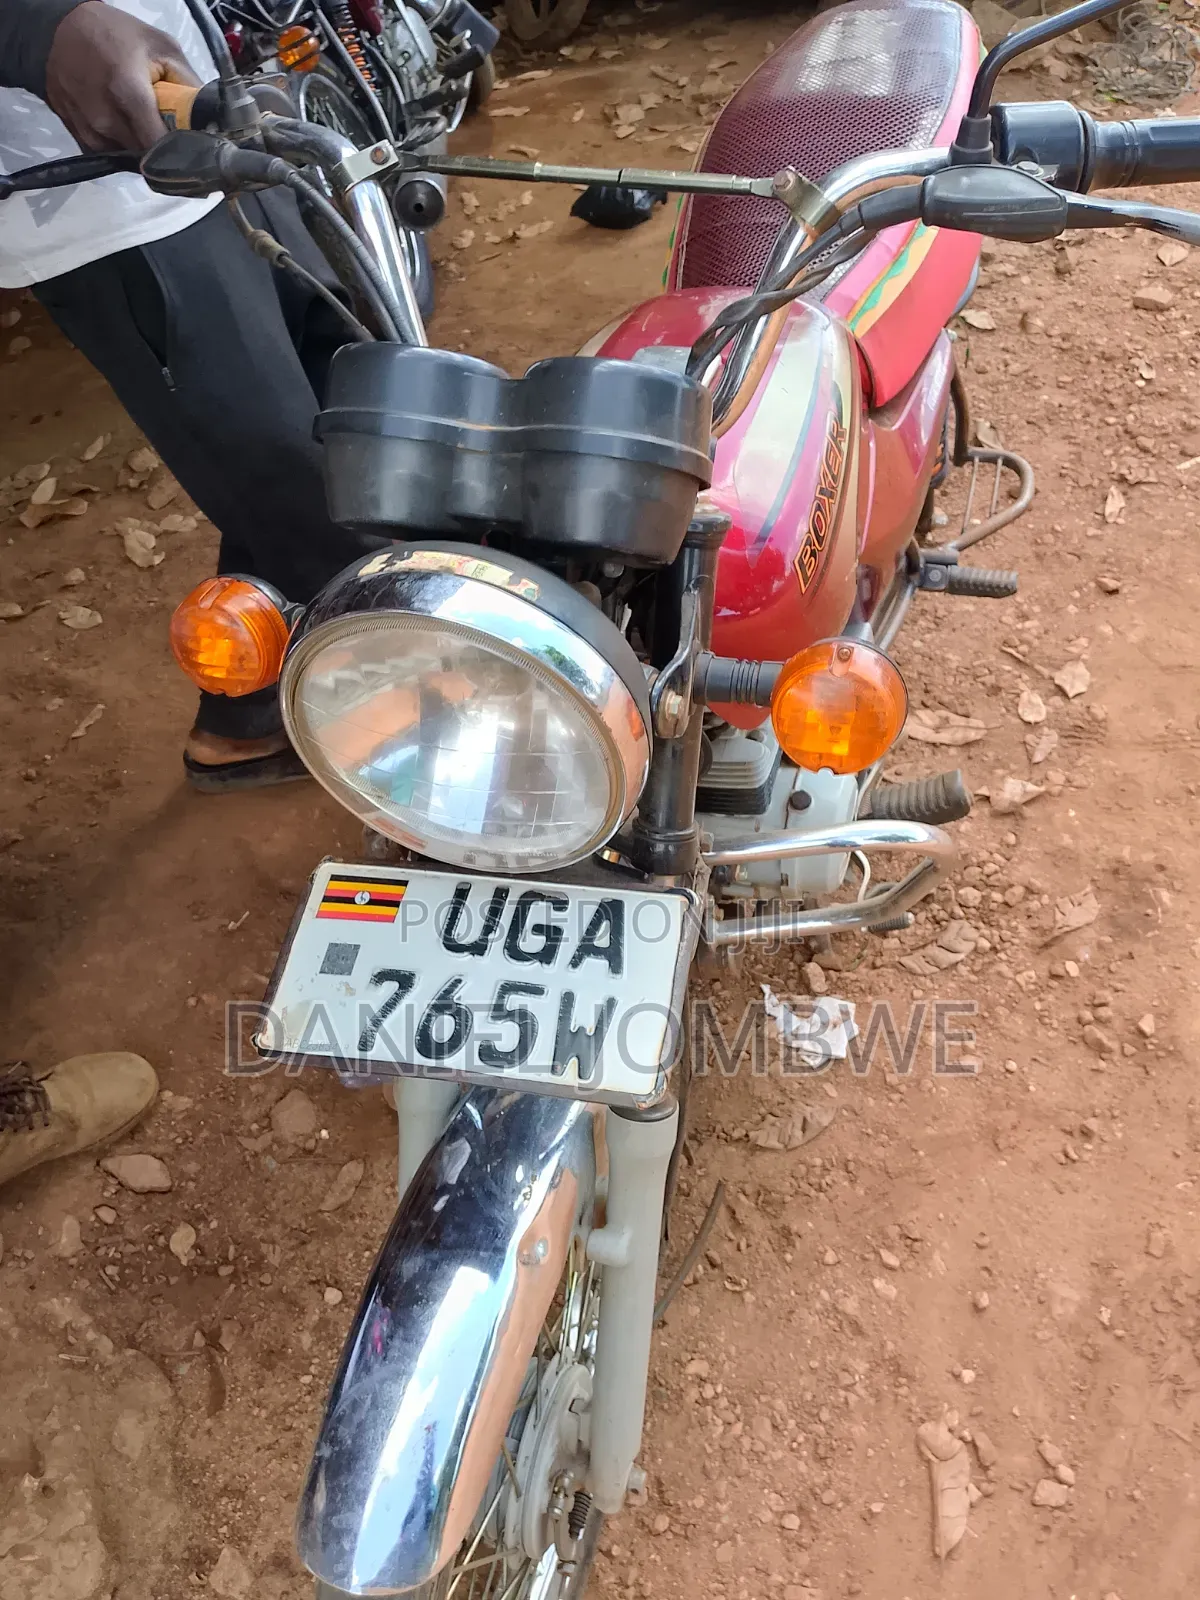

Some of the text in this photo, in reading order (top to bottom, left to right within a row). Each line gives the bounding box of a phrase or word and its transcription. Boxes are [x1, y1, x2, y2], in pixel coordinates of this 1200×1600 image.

[794, 410, 847, 594] BOXER
[442, 881, 625, 976] UGA
[358, 969, 617, 1080] 765W
